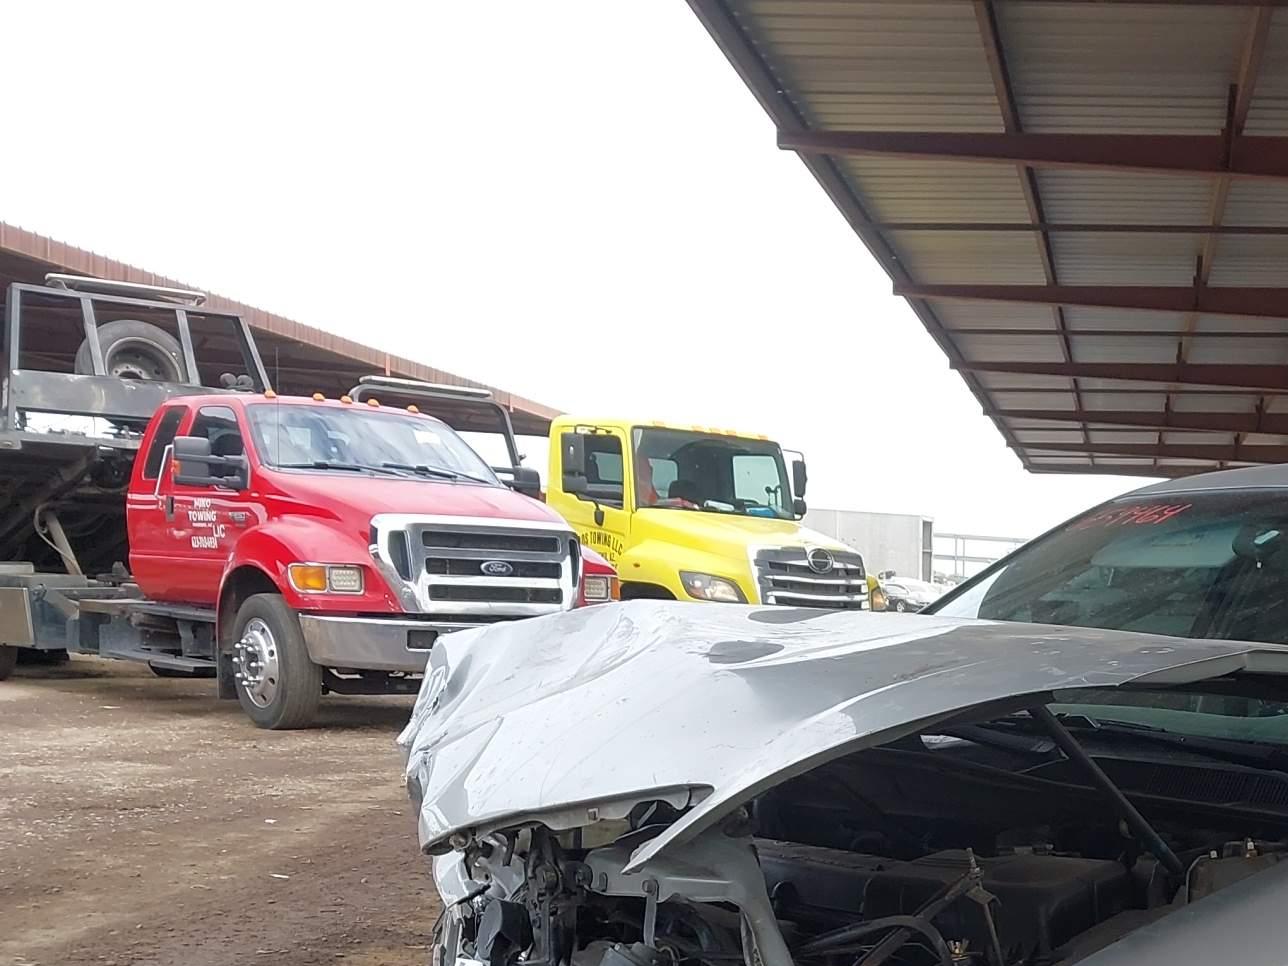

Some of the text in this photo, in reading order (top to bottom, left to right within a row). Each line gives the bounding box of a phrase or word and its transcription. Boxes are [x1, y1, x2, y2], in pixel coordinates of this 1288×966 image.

[187, 510, 217, 522] TOWING
[590, 531, 612, 548] TOWING
[612, 536, 623, 556] LLC
